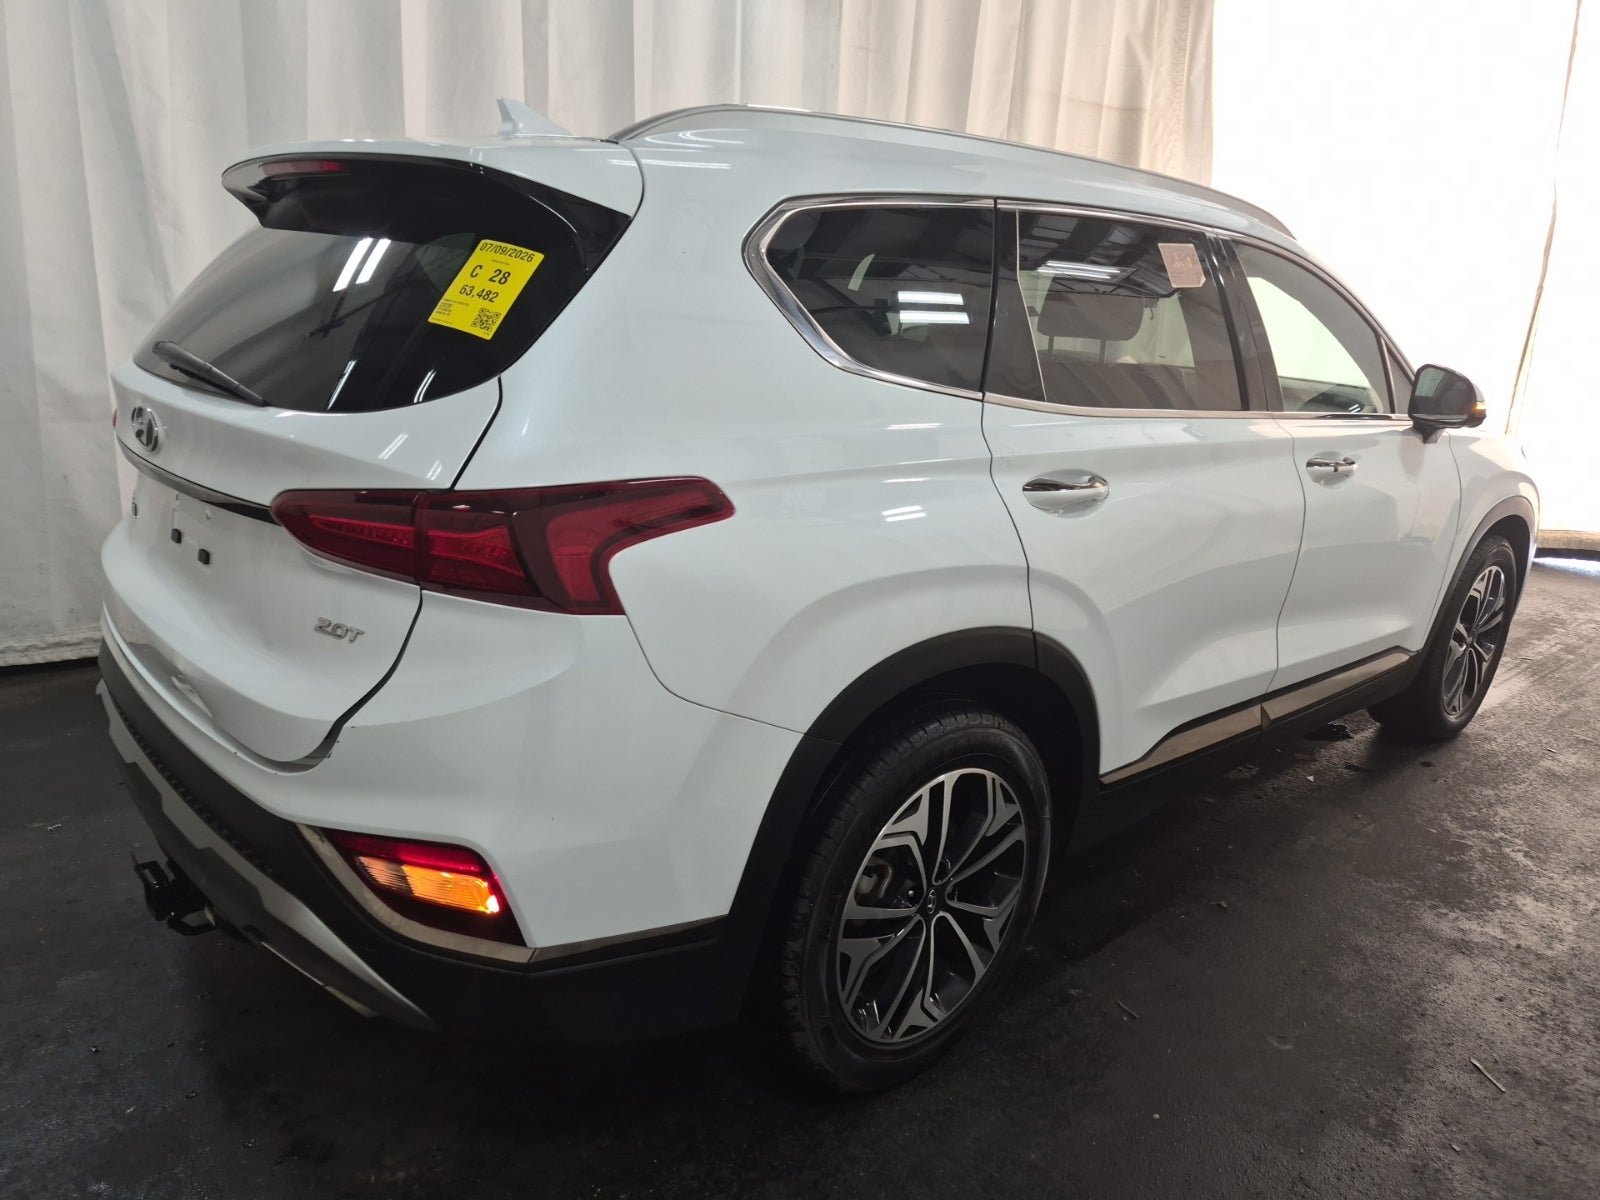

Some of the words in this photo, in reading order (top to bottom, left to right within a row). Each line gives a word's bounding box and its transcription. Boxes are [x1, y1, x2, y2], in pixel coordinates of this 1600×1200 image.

[479, 242, 535, 263] 07/09/2026
[470, 264, 483, 278] C
[488, 269, 511, 285] 28
[459, 284, 499, 303] 63,482
